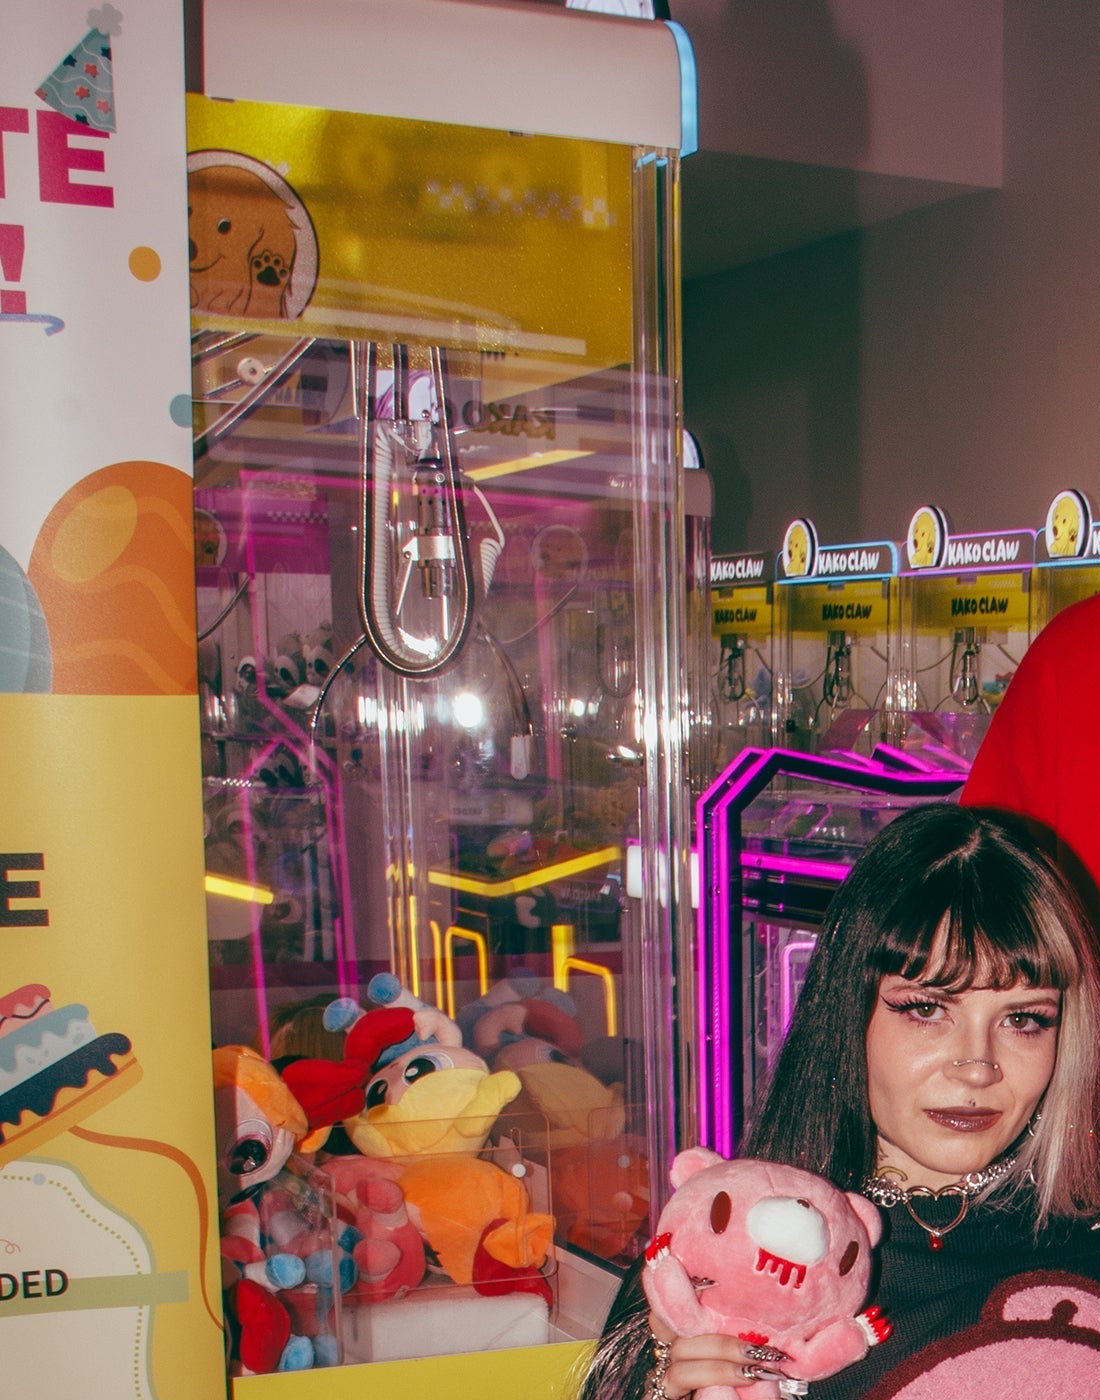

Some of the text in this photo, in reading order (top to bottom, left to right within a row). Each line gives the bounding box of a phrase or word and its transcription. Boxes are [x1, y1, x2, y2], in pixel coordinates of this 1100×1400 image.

[818, 550, 880, 574] KAKO CLAW
[948, 539, 1020, 566] KAKO CLAW
[710, 559, 764, 582] KAKO CLAW
[714, 608, 757, 624] KAKO CLAW
[822, 603, 872, 621] KAKO CLAW
[951, 597, 1009, 616] KAKO CLAW
